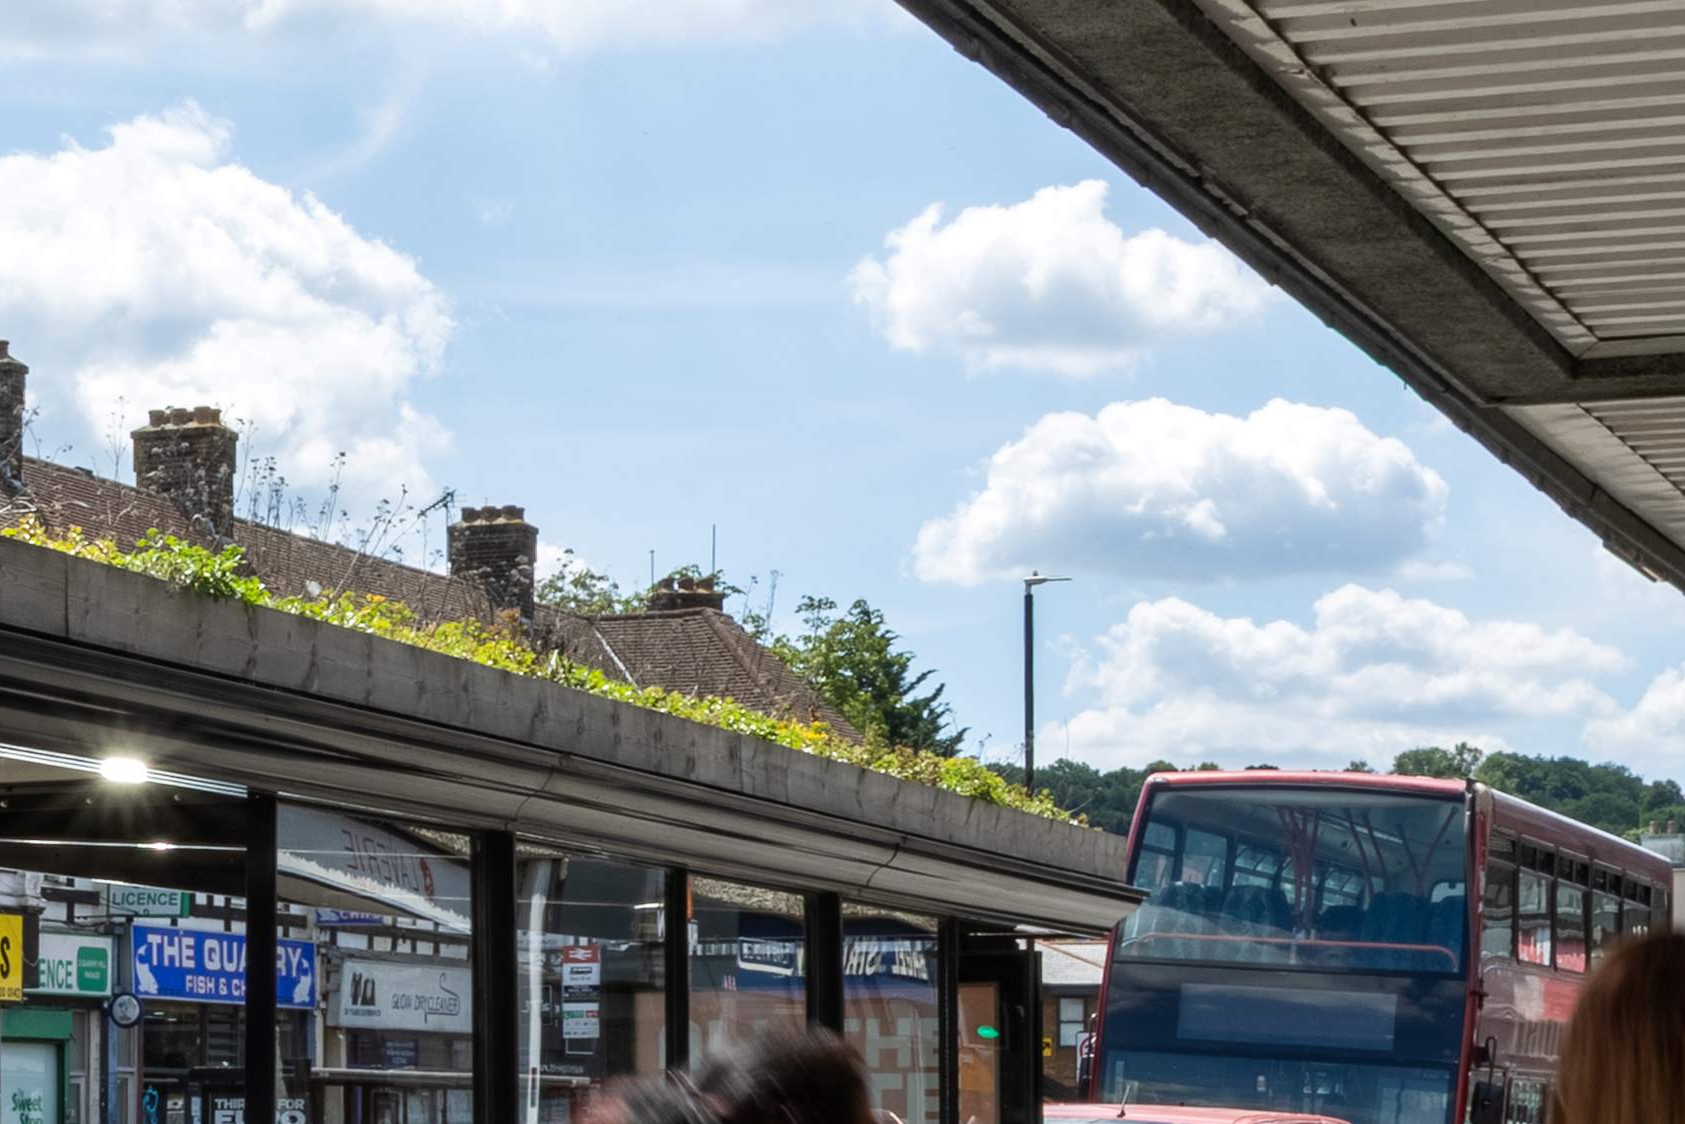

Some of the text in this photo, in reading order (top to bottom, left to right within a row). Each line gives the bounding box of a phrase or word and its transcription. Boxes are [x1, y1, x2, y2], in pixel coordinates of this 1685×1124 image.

[112, 891, 178, 907] LICENCE
[147, 934, 302, 977] THE QUARY
[186, 975, 215, 993] FISH
[219, 979, 228, 995] &
[12, 1092, 44, 1112] Sweet
[277, 1098, 305, 1110] FOR
